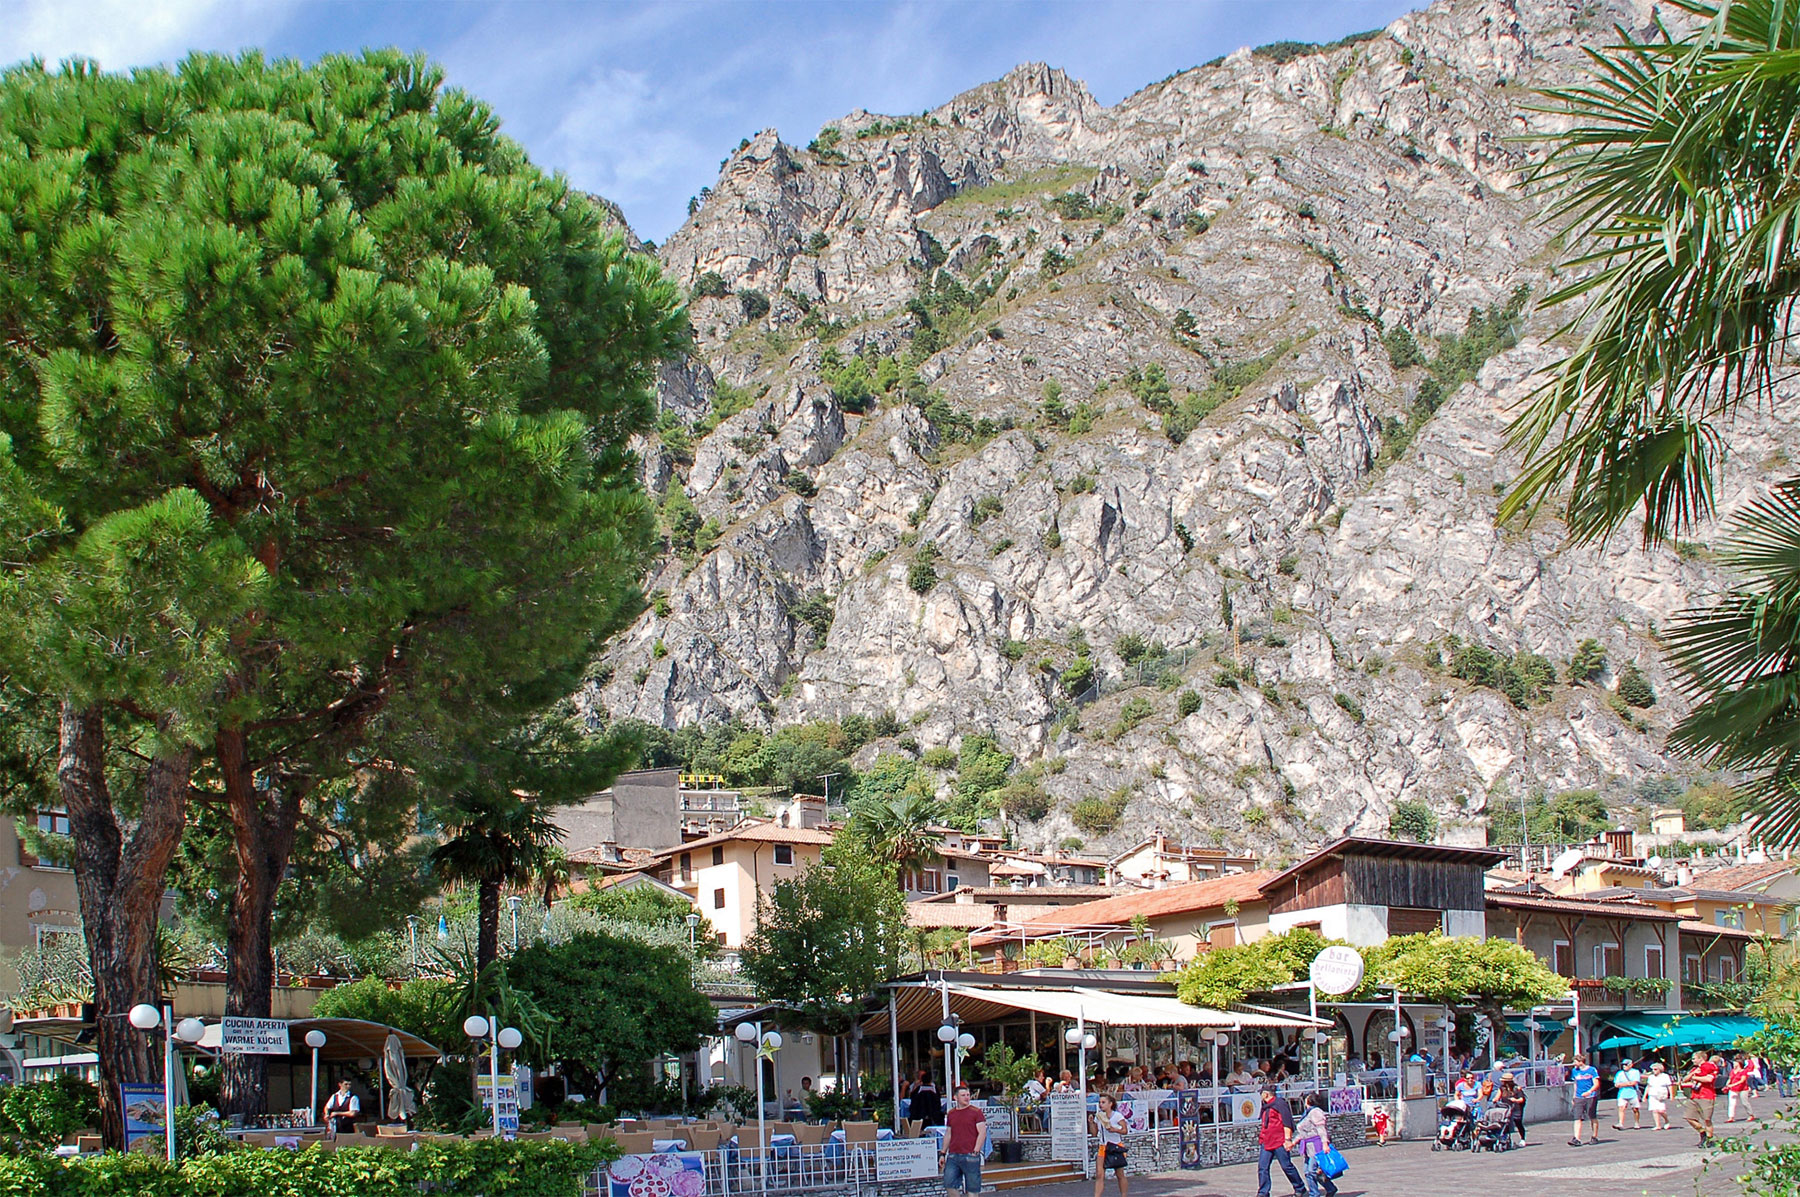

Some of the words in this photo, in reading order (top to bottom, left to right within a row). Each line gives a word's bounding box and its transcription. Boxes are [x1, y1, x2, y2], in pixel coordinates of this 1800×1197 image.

[679, 774, 724, 783] UROPA
[1329, 948, 1349, 961] bar
[1314, 972, 1353, 993] restaurant
[225, 1019, 255, 1029] CUCINA
[257, 1020, 287, 1030] APERTA
[225, 1035, 255, 1044] WARME
